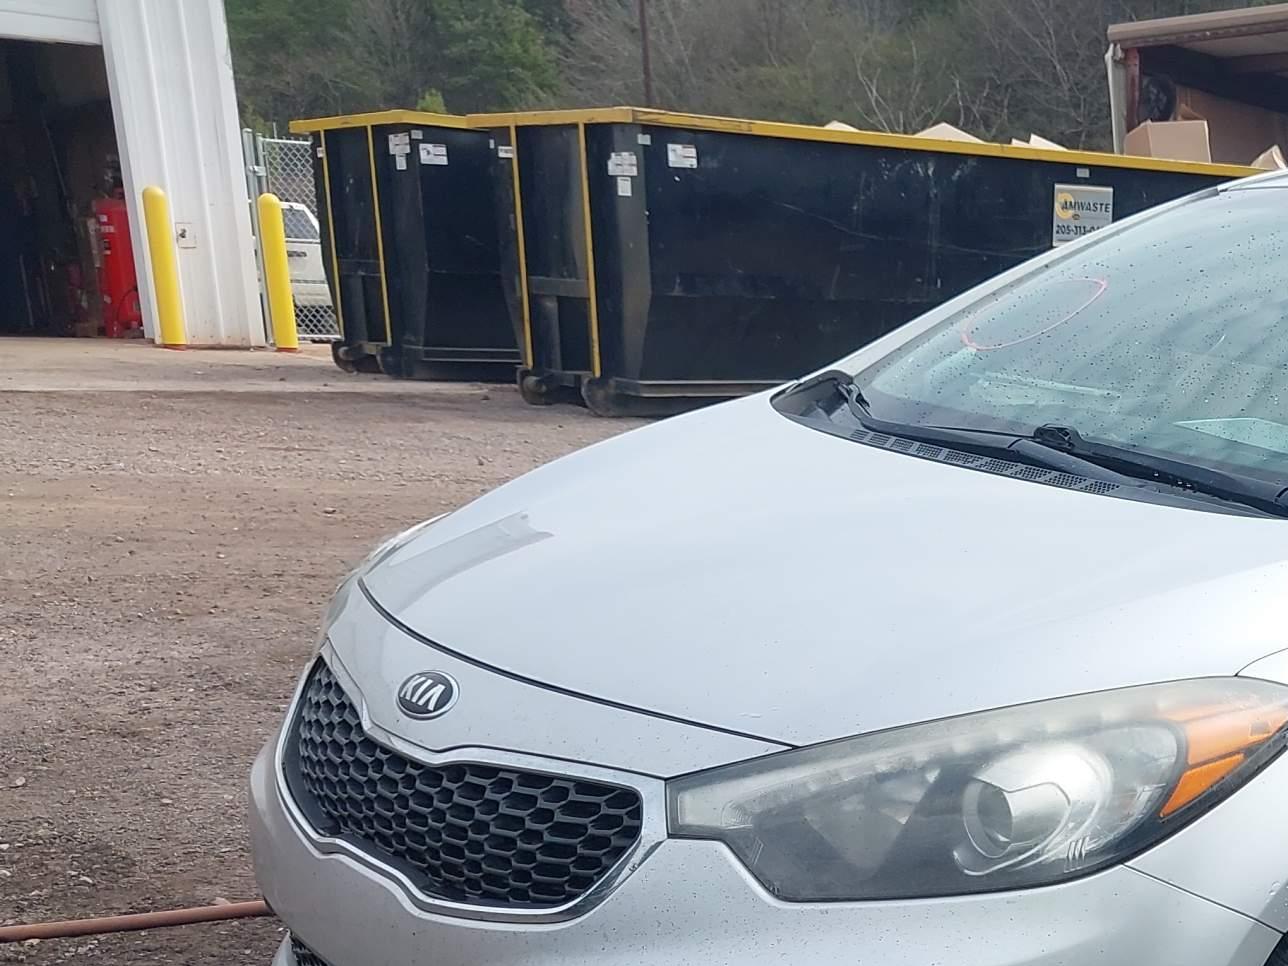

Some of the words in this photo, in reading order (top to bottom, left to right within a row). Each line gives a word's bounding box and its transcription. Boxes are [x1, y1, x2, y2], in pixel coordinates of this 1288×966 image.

[1061, 200, 1111, 213] AMWASTE
[1055, 223, 1103, 236] 205-313-0
[400, 674, 446, 712] KIA
